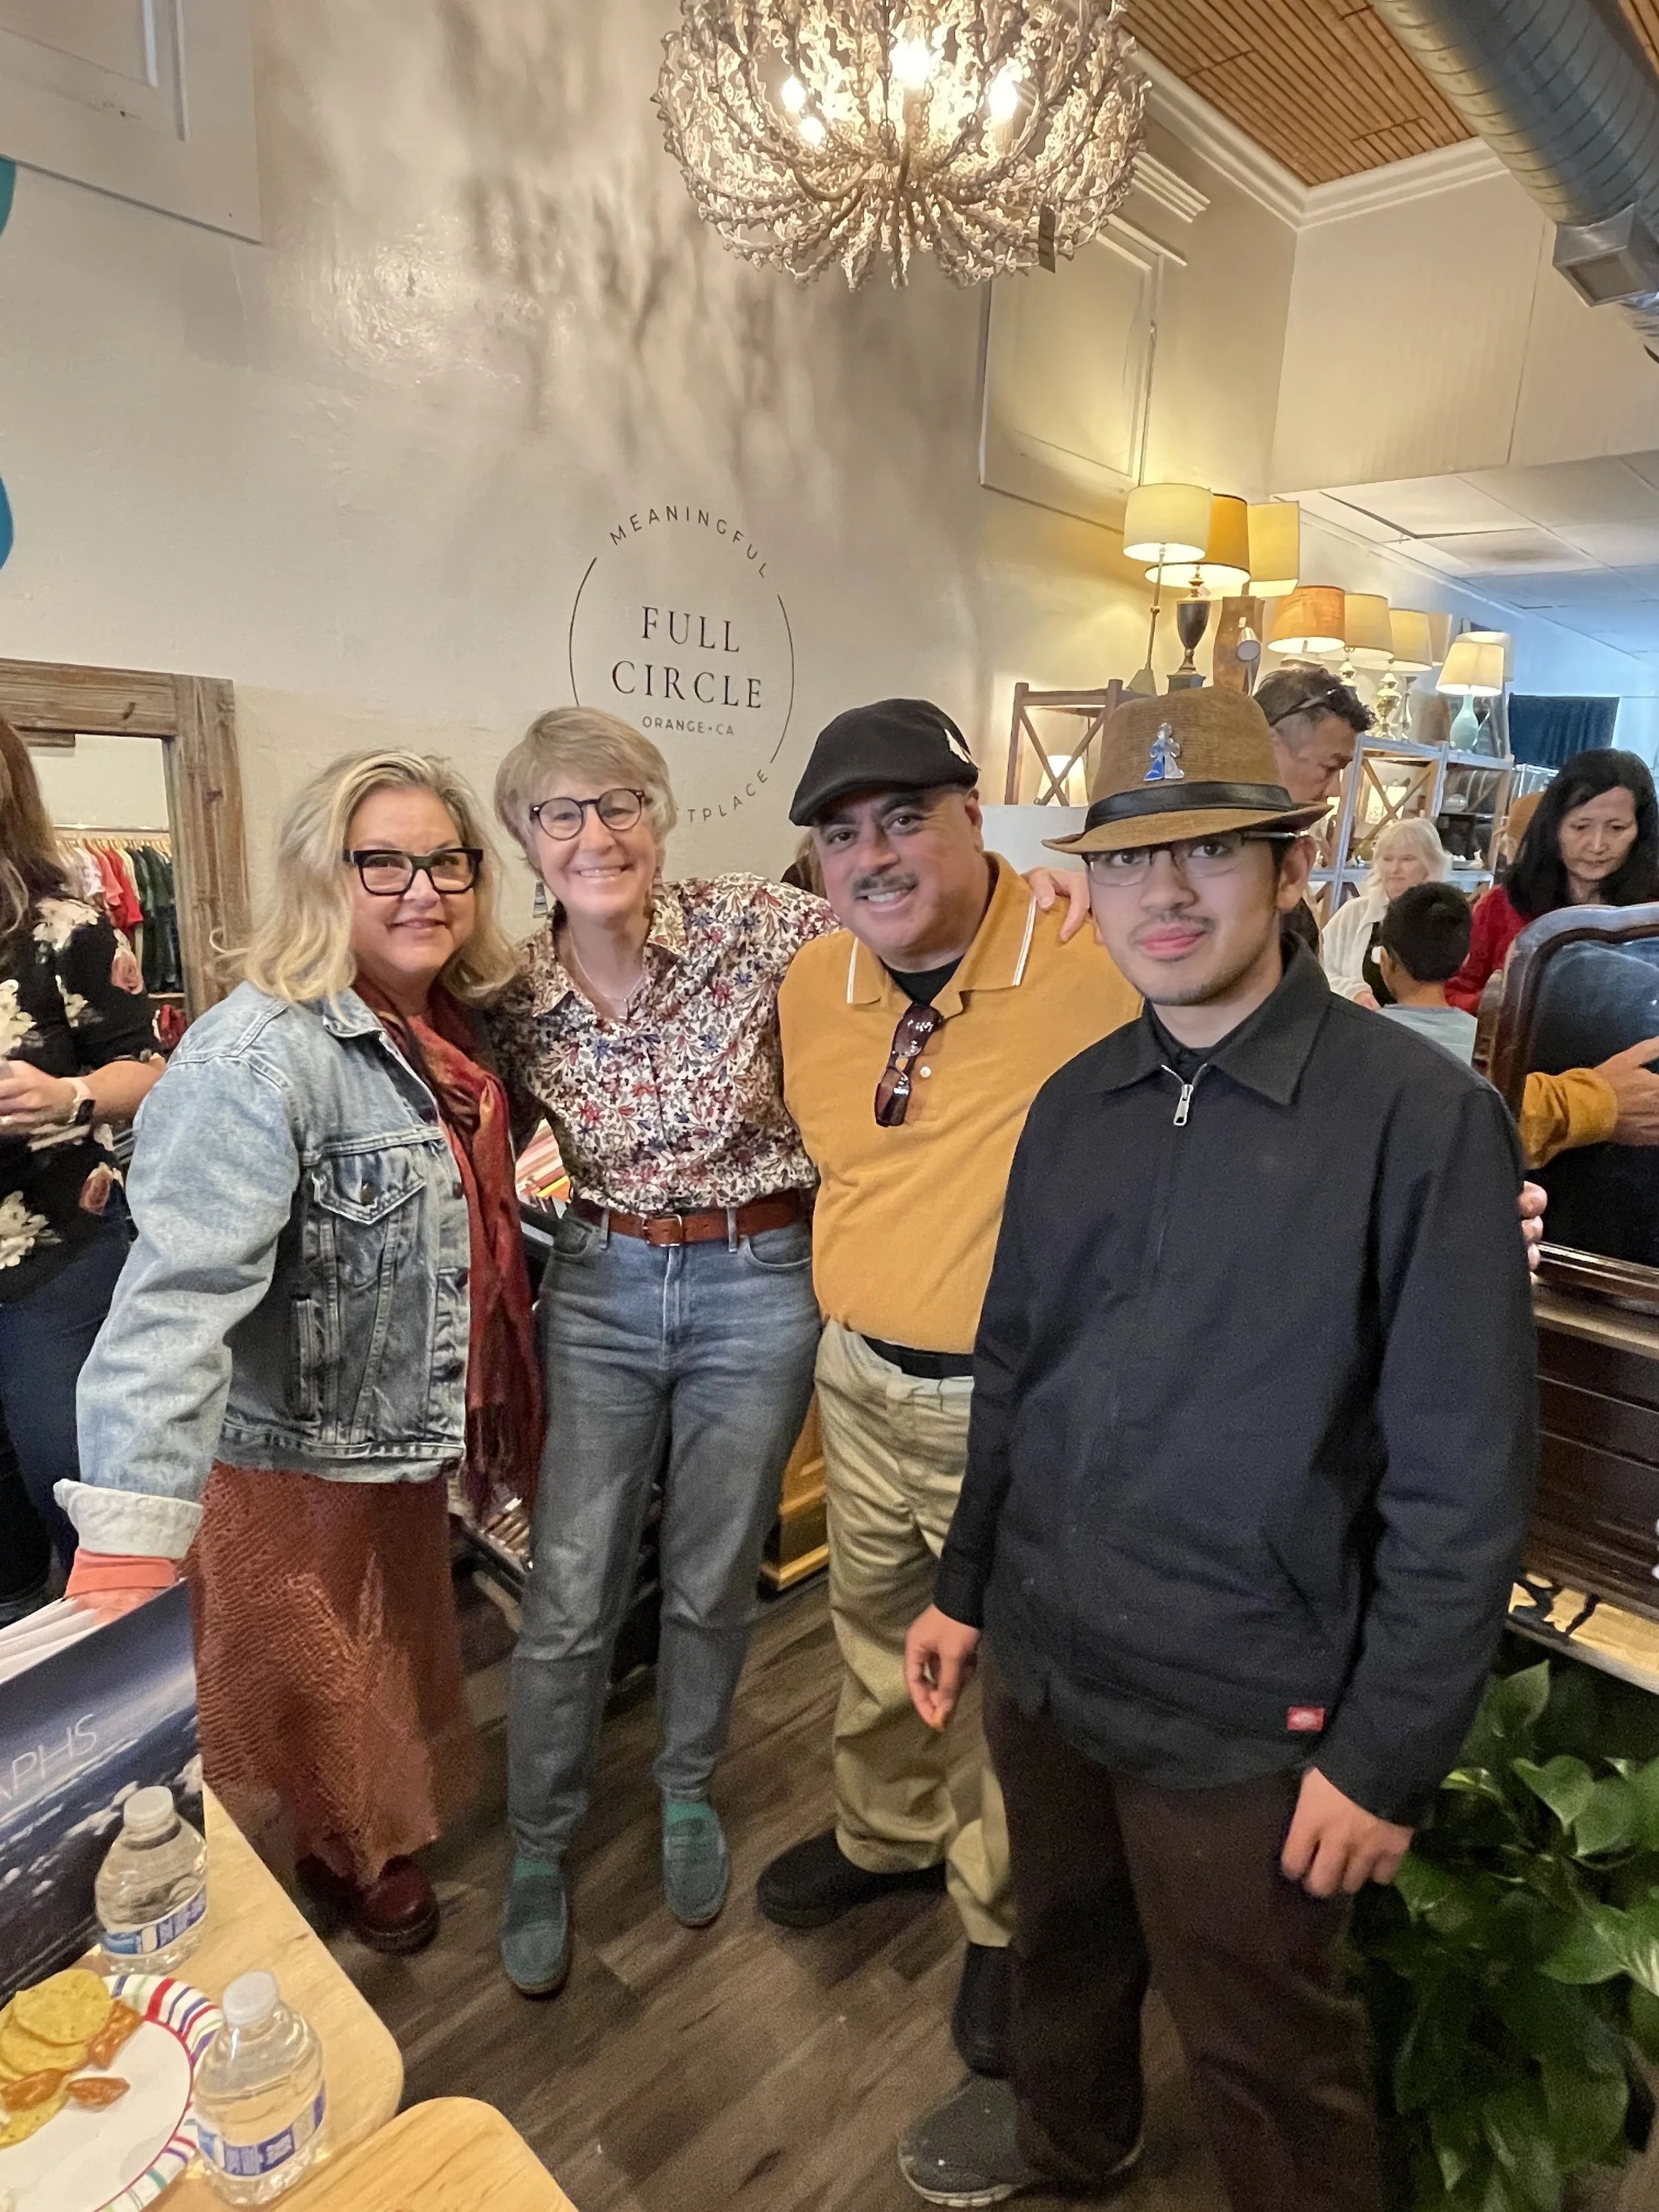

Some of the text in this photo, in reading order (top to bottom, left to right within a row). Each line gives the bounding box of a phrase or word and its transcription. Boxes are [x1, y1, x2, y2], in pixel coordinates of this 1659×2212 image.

[609, 505, 767, 578] MEANINGFUL
[641, 605, 740, 653] FULL
[611, 660, 762, 709] CIRCLE
[677, 769, 768, 823] TPLACE
